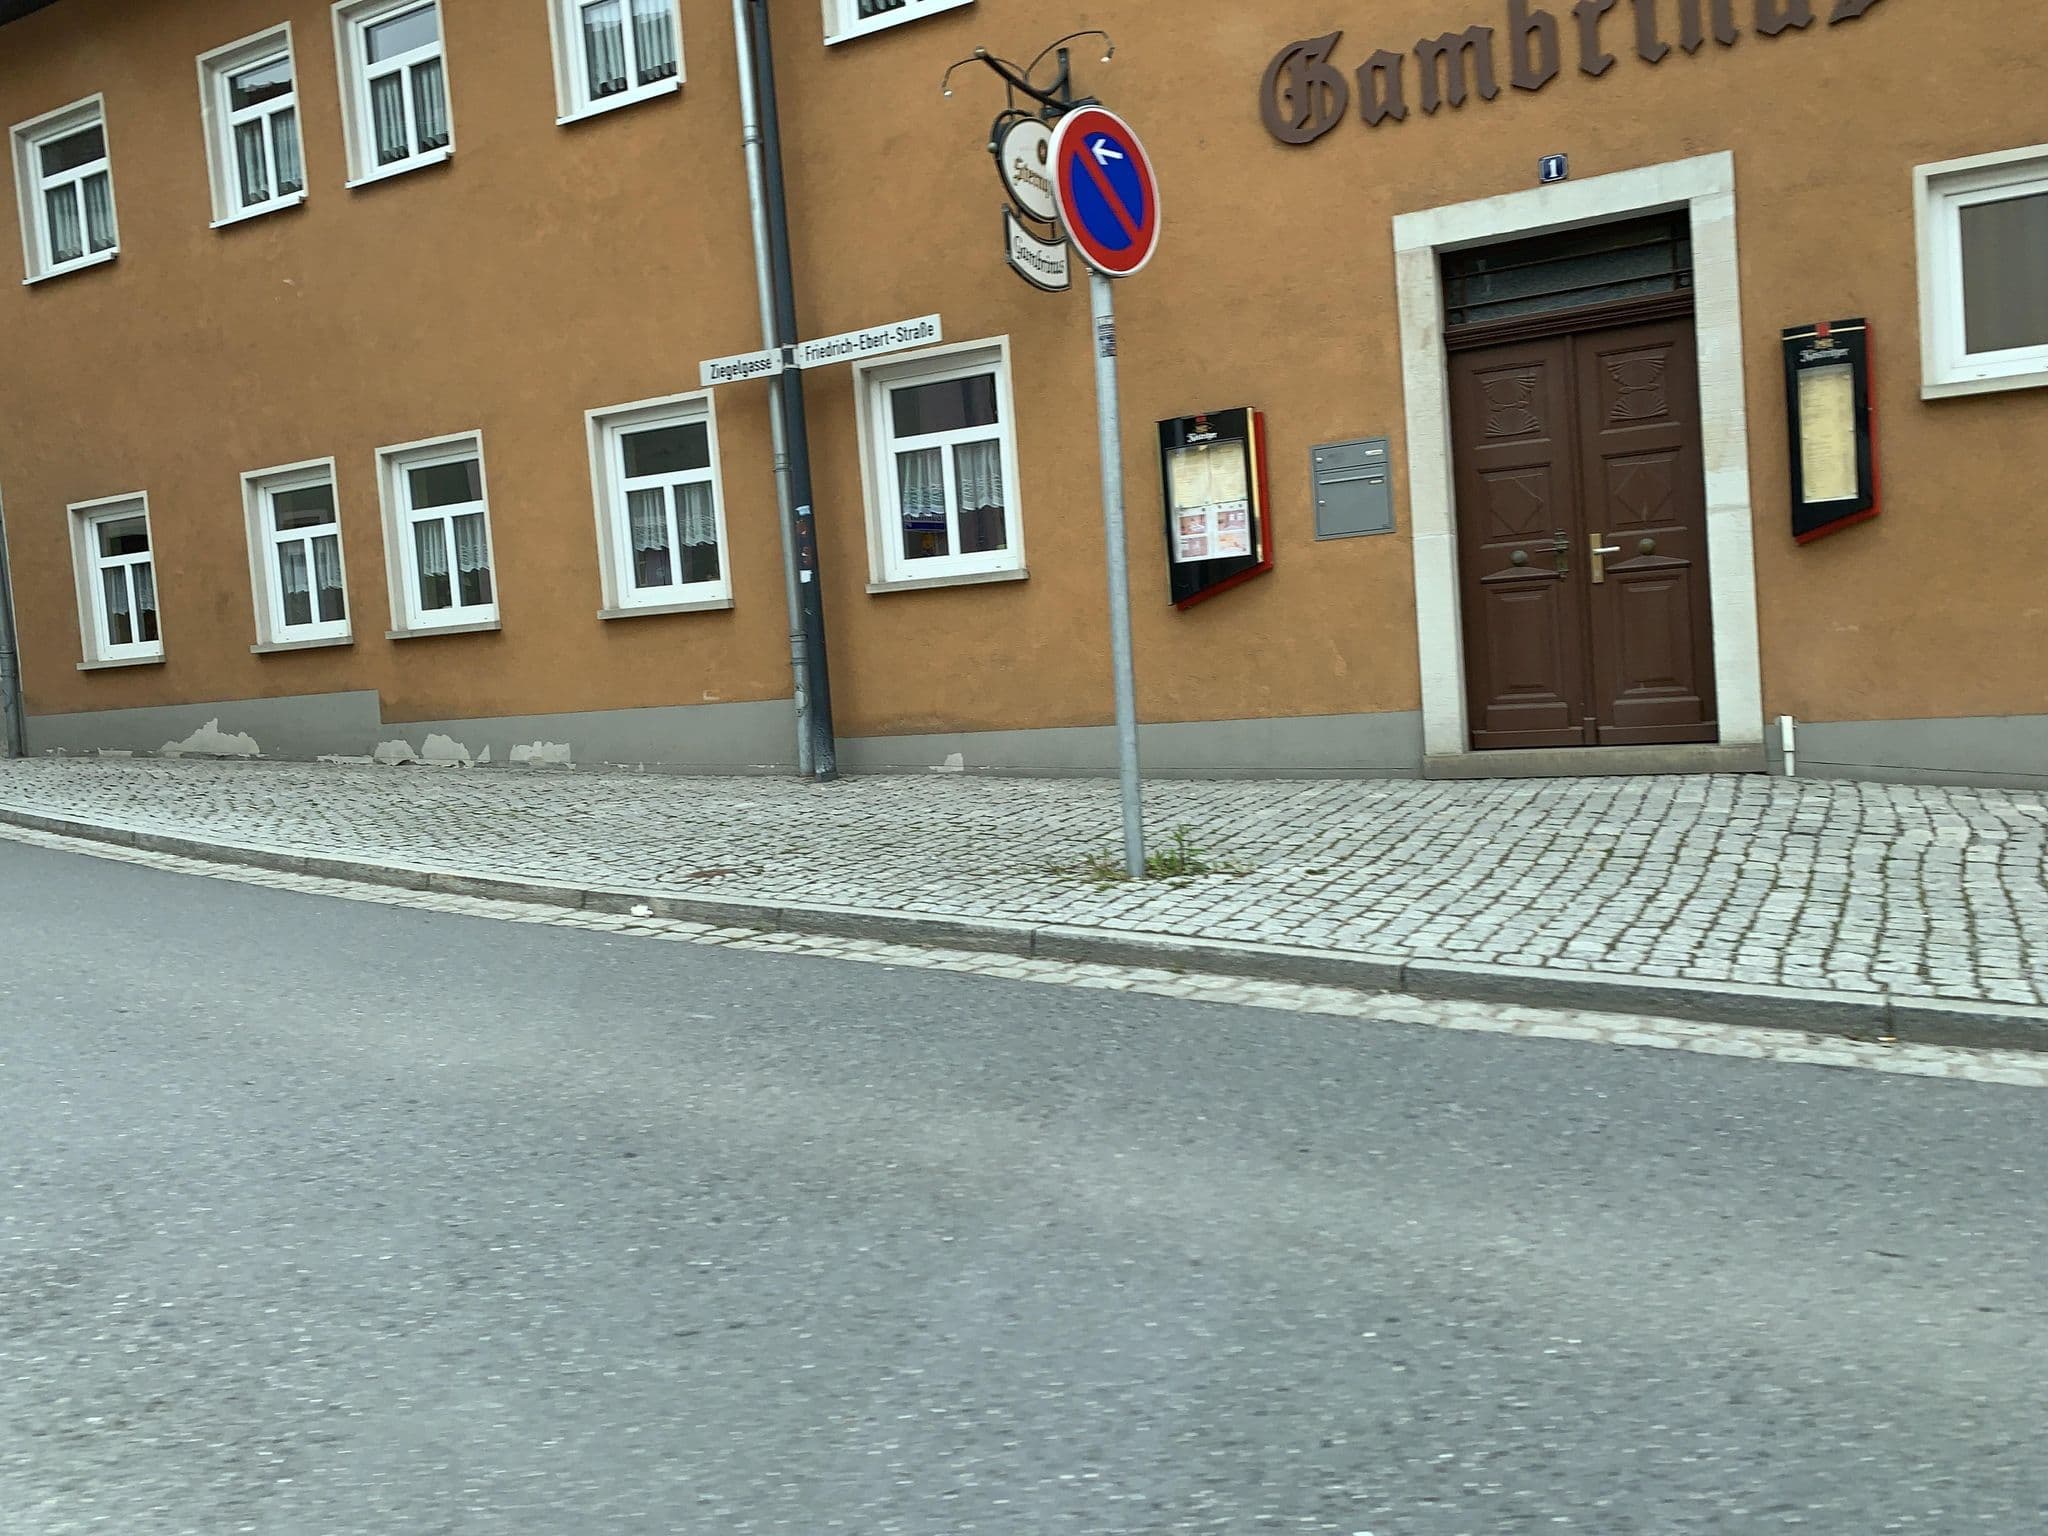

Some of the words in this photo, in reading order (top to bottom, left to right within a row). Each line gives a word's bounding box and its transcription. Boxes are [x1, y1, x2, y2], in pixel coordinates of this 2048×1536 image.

[1548, 159, 1559, 178] 1
[804, 322, 935, 362] Friedrich-Ebert-Straße
[709, 356, 772, 381] Ziegelgasse
